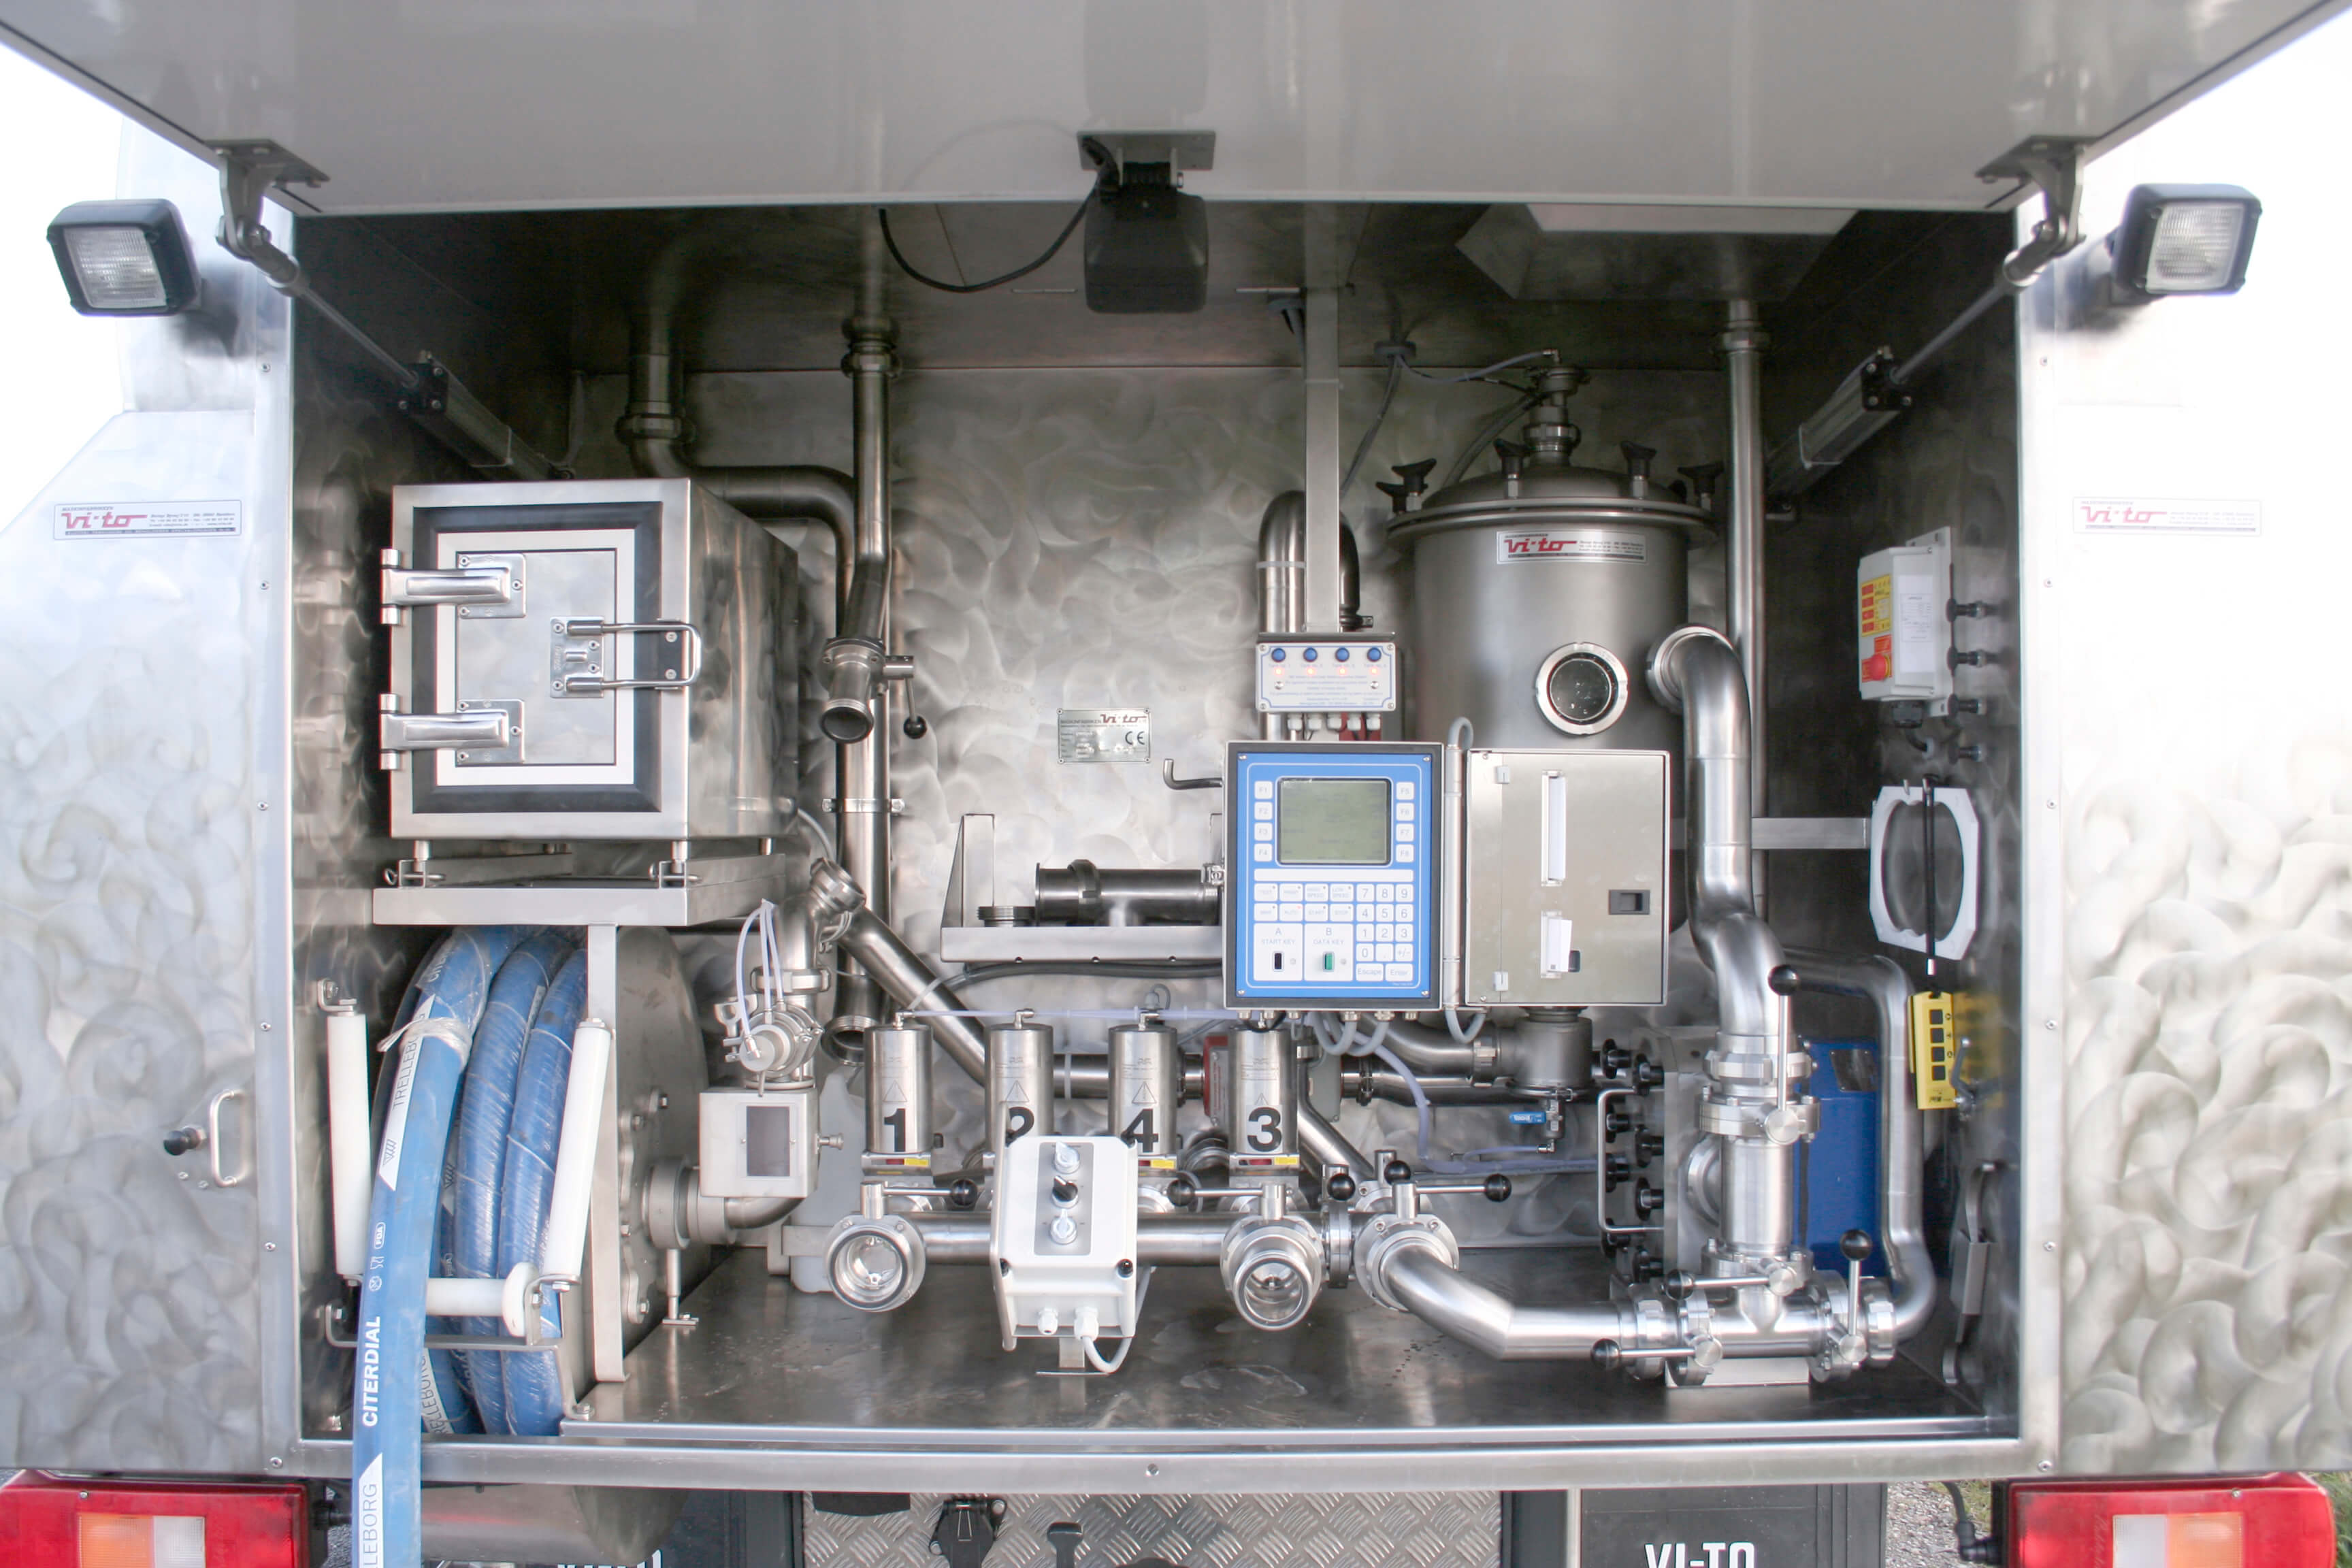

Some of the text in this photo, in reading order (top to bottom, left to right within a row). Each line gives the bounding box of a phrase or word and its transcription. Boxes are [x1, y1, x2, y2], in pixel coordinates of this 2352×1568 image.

[1360, 888, 1369, 898] 7
[1381, 888, 1389, 898] 8
[1401, 888, 1408, 898] 9
[1362, 909, 1369, 918] 4
[1381, 909, 1388, 918] 5
[1401, 909, 1408, 918] 6
[1275, 928, 1282, 936] A
[1326, 928, 1333, 936] B
[1381, 928, 1388, 938] 2
[1401, 928, 1407, 938] 3
[1362, 948, 1369, 958] 0
[1358, 968, 1382, 976] Escape
[884, 1109, 906, 1152] 1
[1122, 1109, 1158, 1153] 4
[1247, 1107, 1282, 1152] 3
[362, 1316, 380, 1427] CITERDIAL
